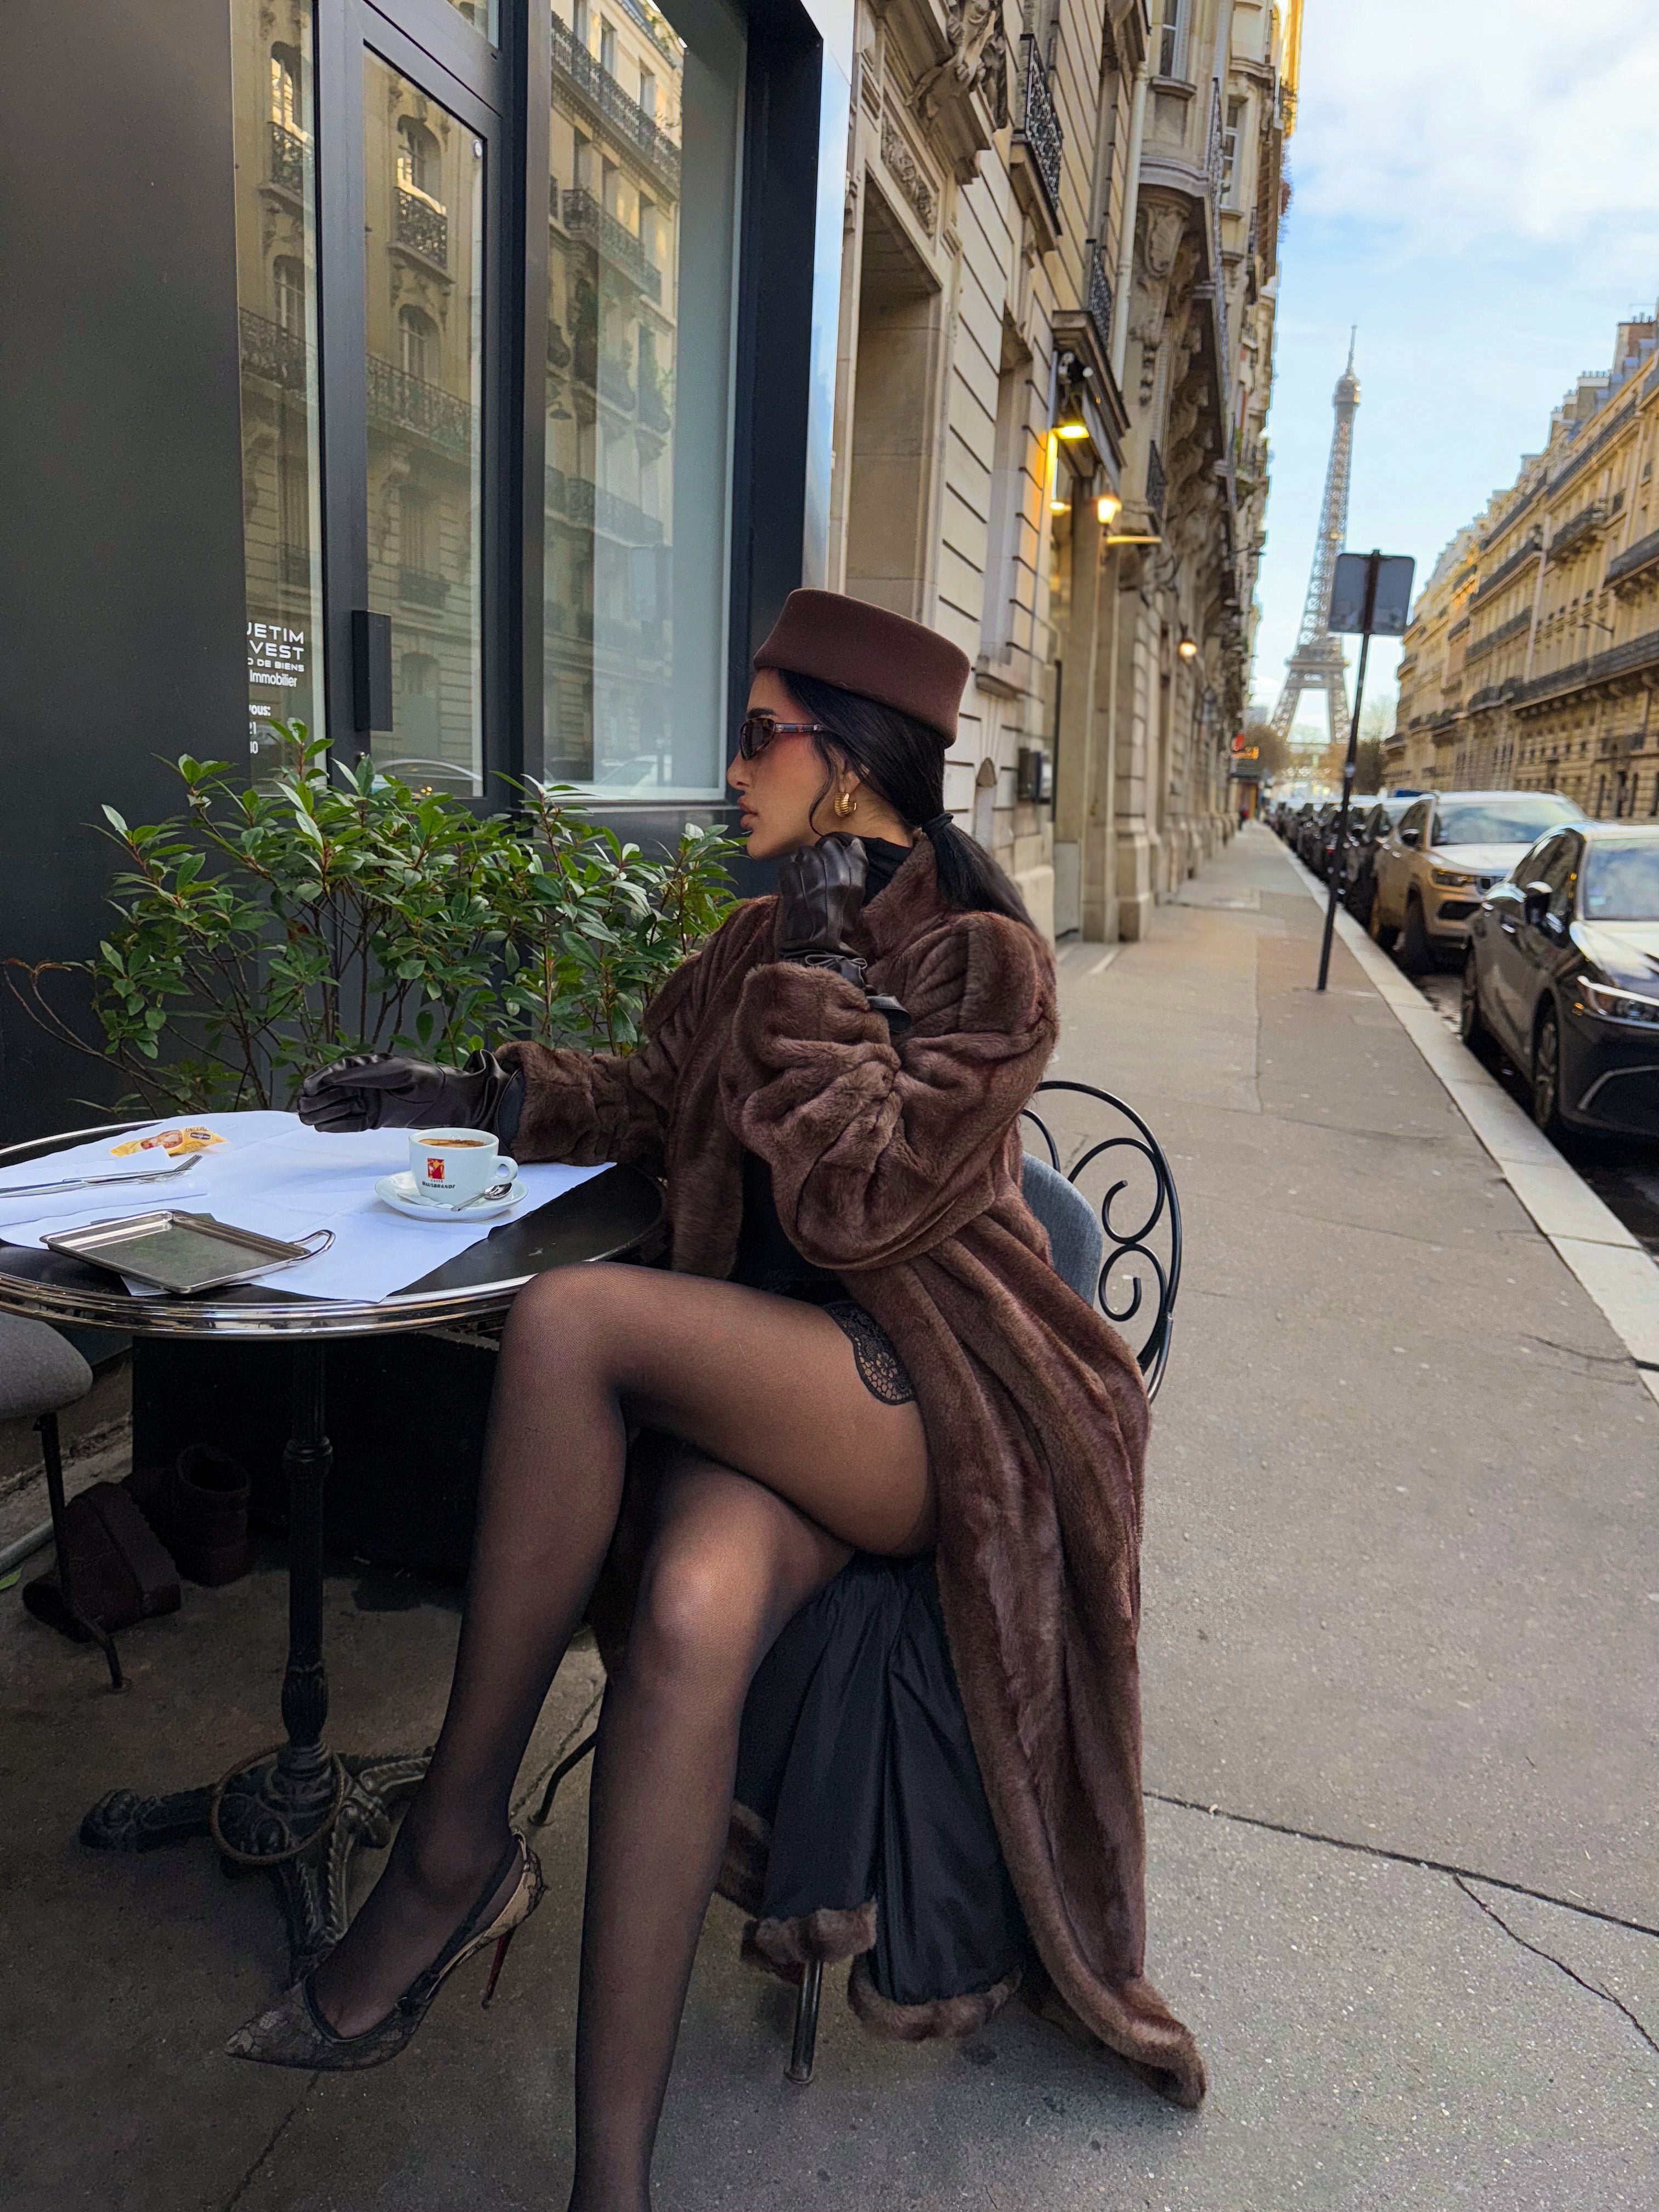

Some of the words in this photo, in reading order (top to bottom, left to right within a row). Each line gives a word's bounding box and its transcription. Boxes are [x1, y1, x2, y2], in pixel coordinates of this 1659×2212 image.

[249, 640, 304, 661] VEST
[257, 658, 272, 668] DE
[274, 661, 304, 672] BIENS
[249, 669, 297, 687] Immobilier
